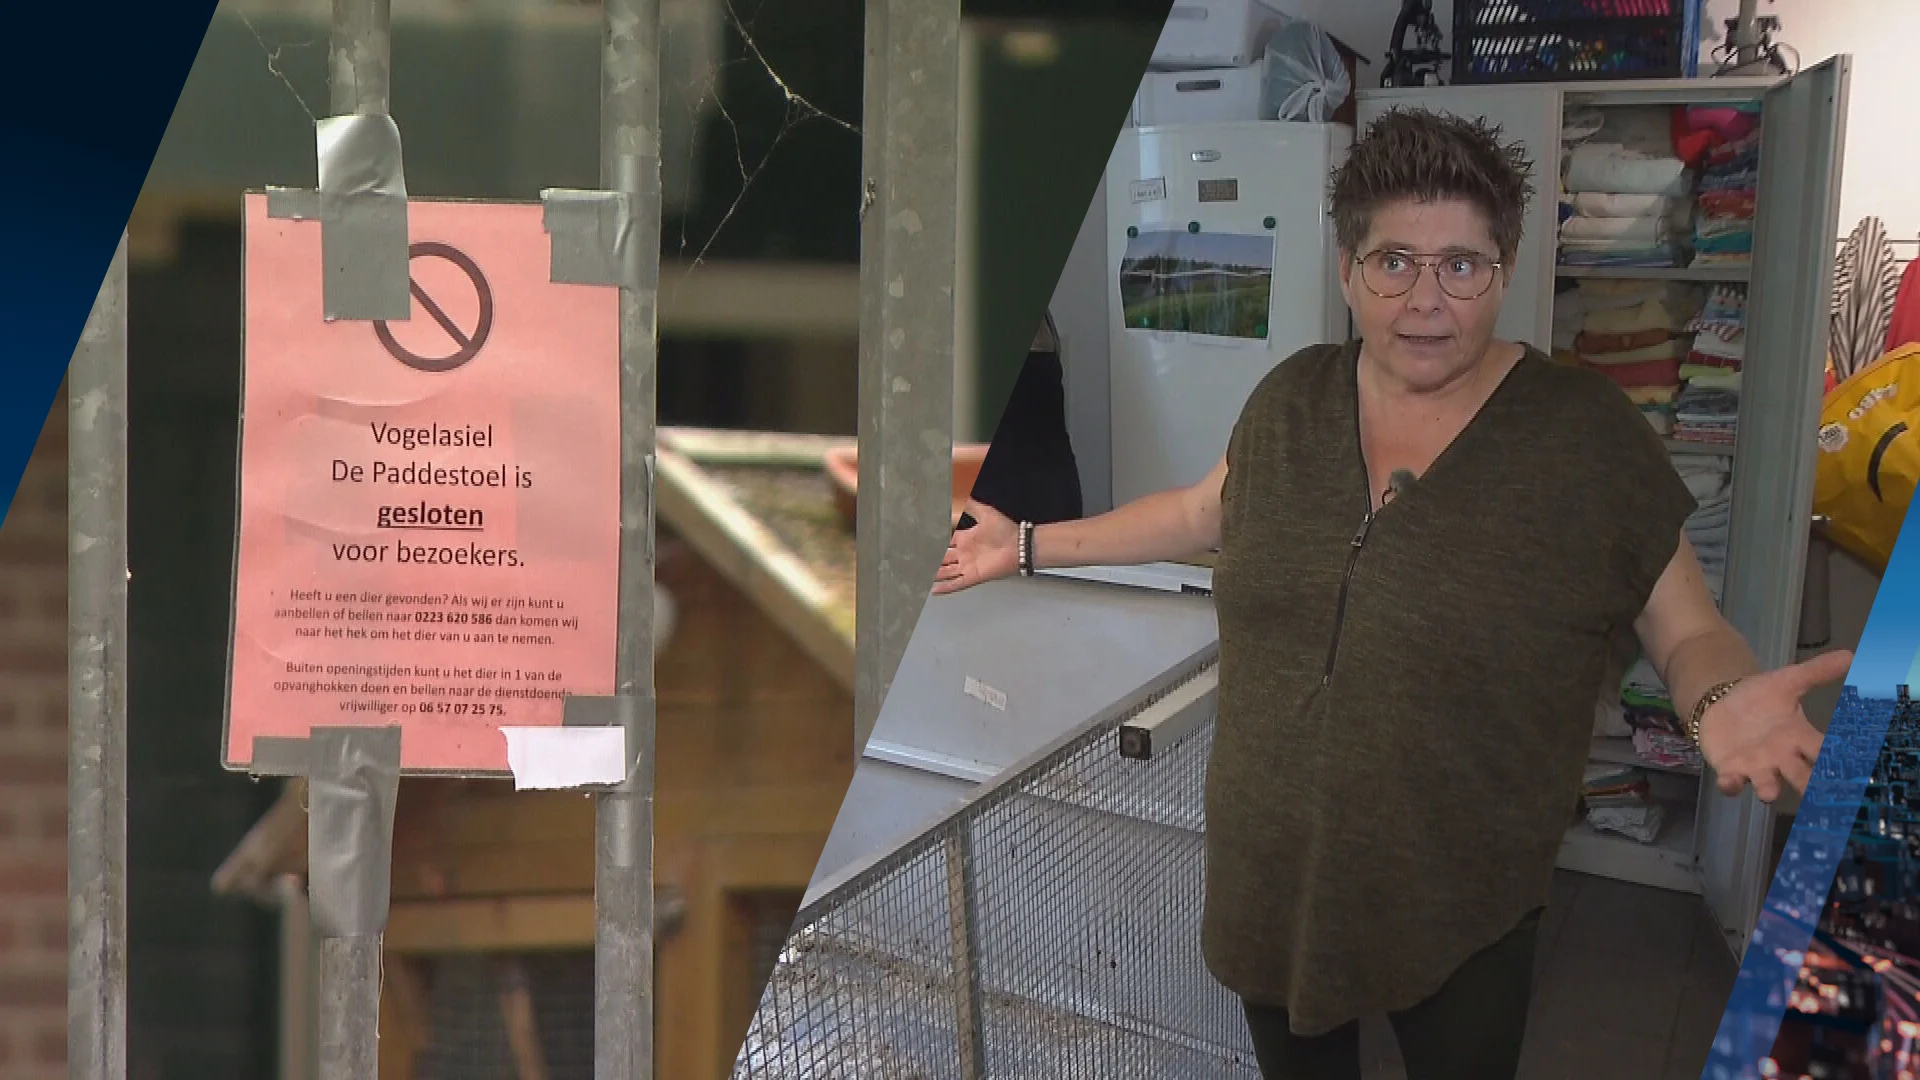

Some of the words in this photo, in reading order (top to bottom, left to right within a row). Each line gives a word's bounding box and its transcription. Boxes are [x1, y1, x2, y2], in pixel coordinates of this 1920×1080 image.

[371, 422, 492, 450] Vogelasiel
[332, 459, 364, 482] De
[372, 461, 507, 487] Paddestoel
[515, 466, 533, 489] is
[377, 501, 484, 530] gesloten
[333, 543, 389, 563] voor
[397, 540, 525, 567] bezoekers.
[290, 589, 321, 601] Heeft
[325, 593, 332, 601] u
[335, 593, 356, 602] een
[360, 591, 382, 603] dier
[385, 593, 448, 606] gevonden?
[451, 594, 468, 607] Als
[471, 595, 488, 608] wij
[491, 598, 501, 607] er
[506, 597, 525, 610] zijn
[528, 597, 553, 609] kunt
[556, 600, 564, 609] u
[274, 607, 330, 619] aanbellen
[333, 608, 345, 620] of
[348, 609, 383, 621] bellen
[386, 613, 412, 622] naar
[415, 611, 443, 623] 0223
[446, 613, 468, 624] 620
[471, 613, 492, 625] 586
[495, 614, 517, 625] dan
[520, 615, 558, 627] komen
[562, 617, 579, 630] wij
[295, 627, 321, 637] naar
[324, 625, 343, 638] het
[346, 626, 367, 639] hek
[370, 630, 389, 639] om
[392, 628, 411, 640] het
[414, 629, 437, 641] dier
[439, 632, 460, 641] van
[463, 633, 471, 642] u
[473, 633, 494, 643] aan
[497, 632, 508, 644] te
[286, 661, 323, 673] Buiten
[326, 663, 411, 678] openingstijden
[414, 665, 439, 677] kunt
[443, 668, 450, 677] u
[453, 667, 472, 678] het
[475, 667, 497, 679] dier
[500, 668, 511, 680] in
[514, 669, 521, 680] 1
[524, 672, 545, 681] van
[547, 670, 562, 681] de
[273, 680, 357, 694] opvanghokken
[360, 681, 390, 693] doen
[393, 685, 407, 694] en
[410, 683, 445, 696] bellen
[448, 686, 475, 697] naar
[477, 685, 492, 697] de
[339, 699, 398, 714] vrijwilliger
[401, 703, 416, 715] op
[419, 702, 434, 713] 06
[437, 703, 451, 714] 57
[454, 703, 468, 714] 07
[471, 704, 485, 715] 25
